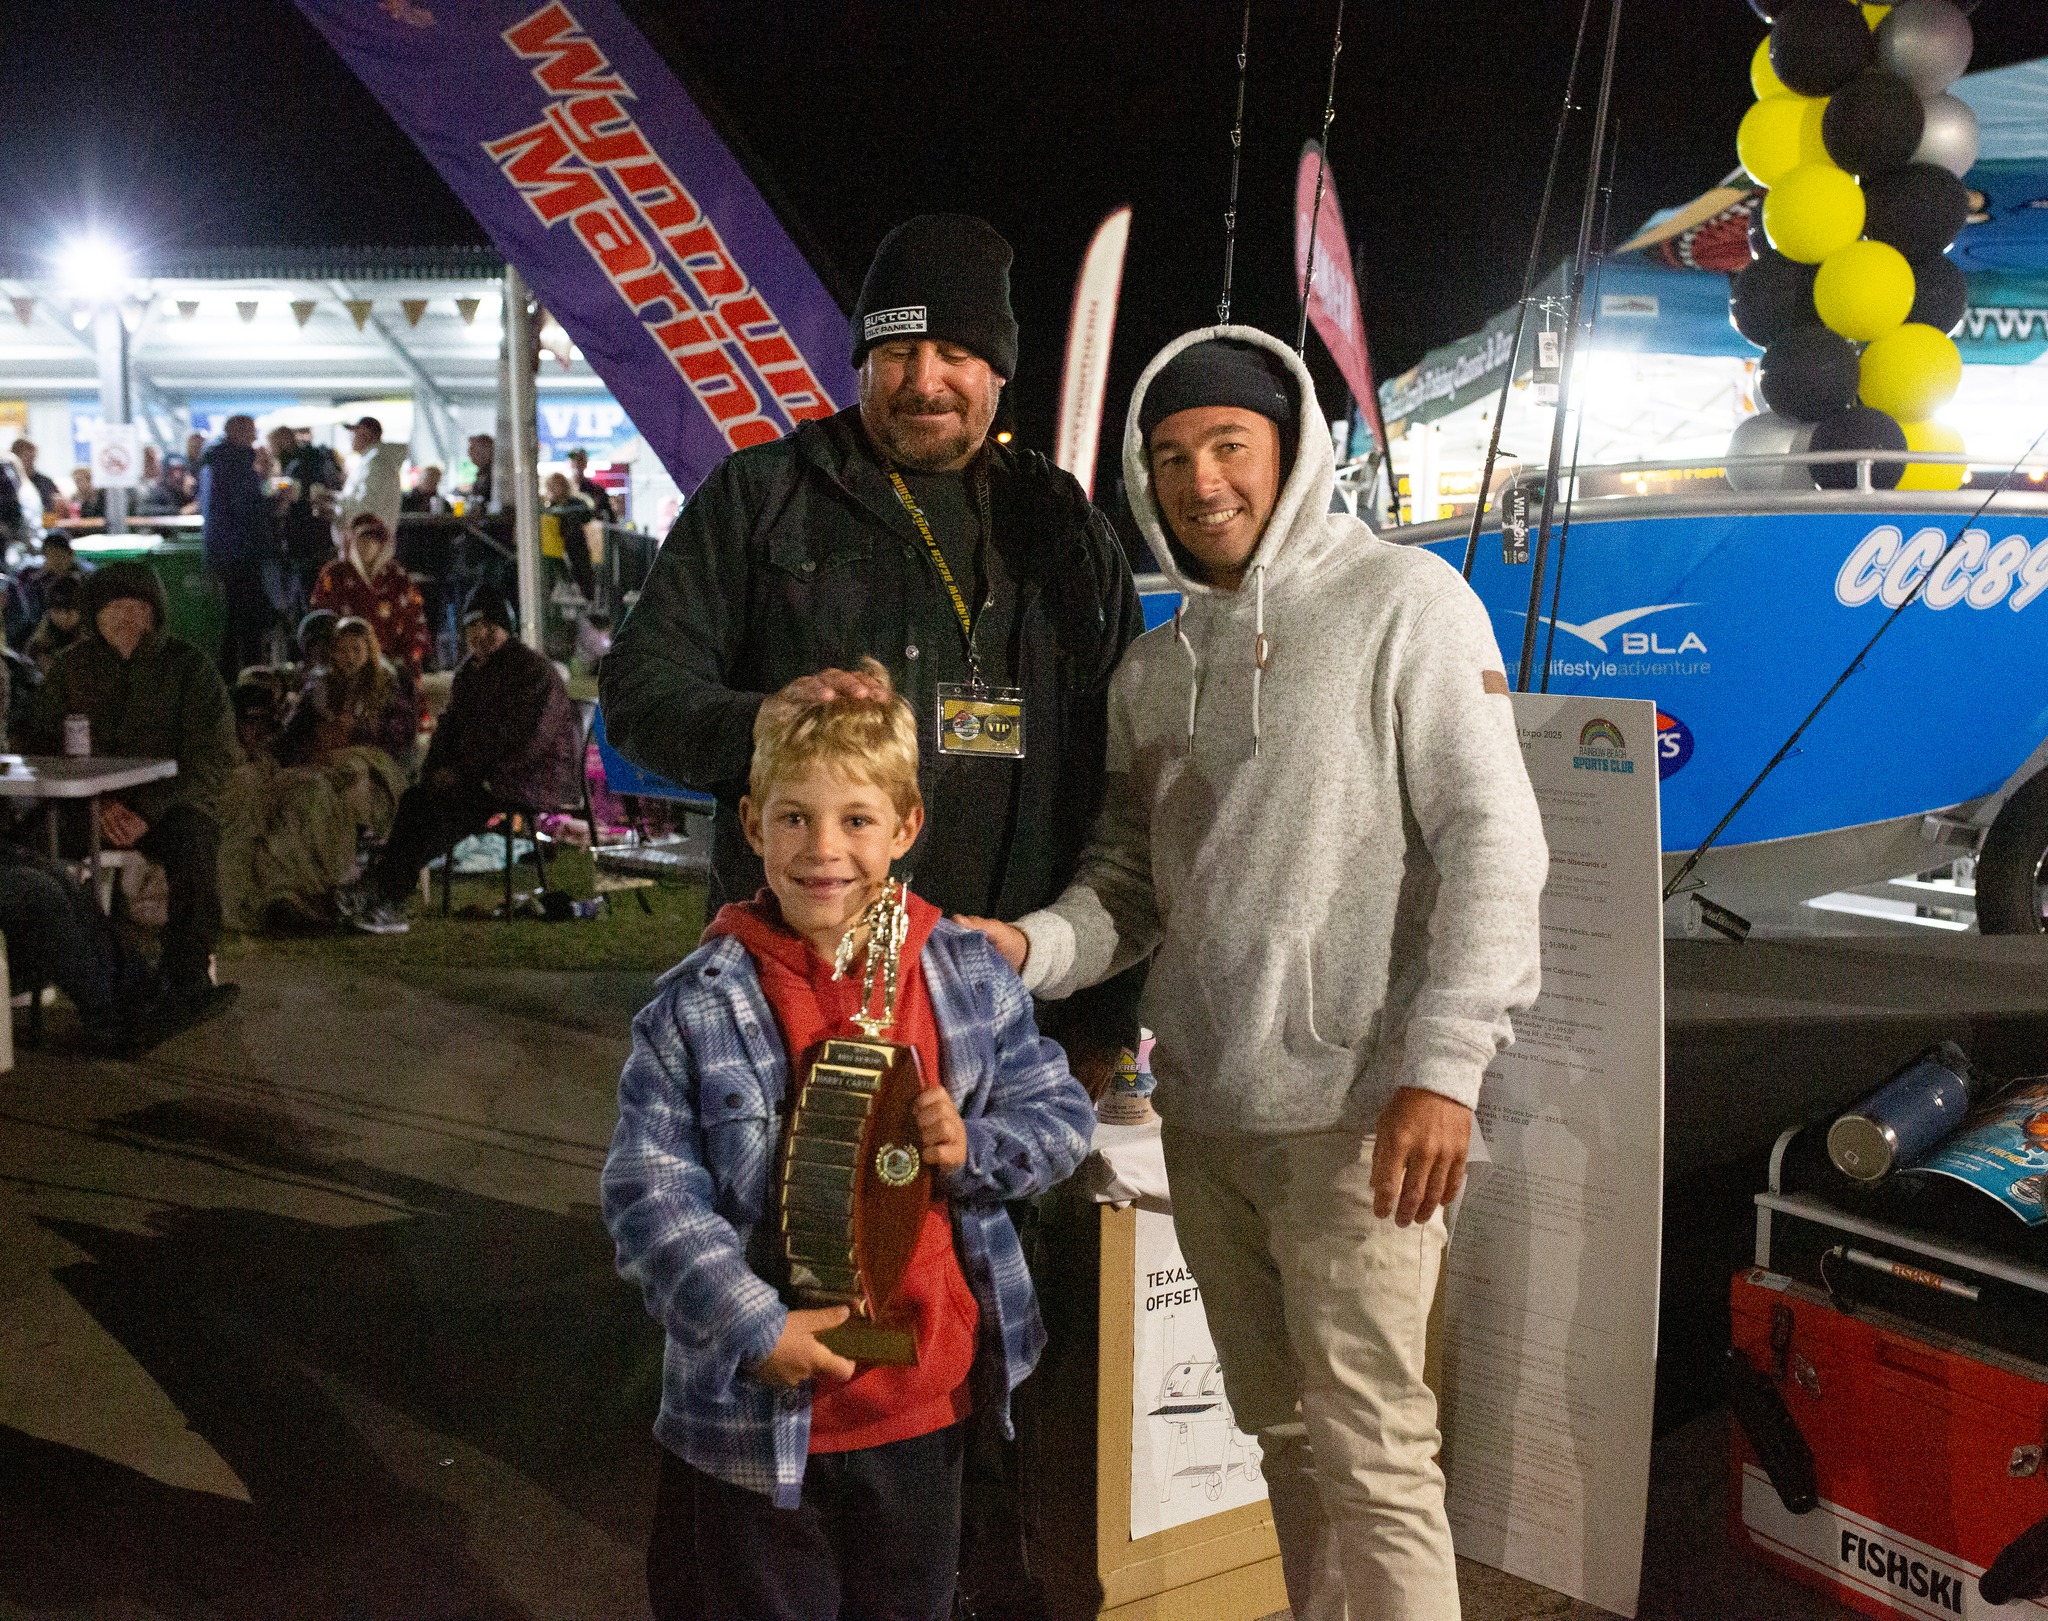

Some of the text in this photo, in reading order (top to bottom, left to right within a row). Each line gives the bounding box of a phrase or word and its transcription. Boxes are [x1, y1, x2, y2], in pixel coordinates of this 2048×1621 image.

[864, 310, 923, 328] BURTON
[888, 471, 918, 512] FISHING
[911, 511, 937, 548] FAMILY
[1513, 496, 1525, 547] WILSON
[930, 549, 955, 582] BEACH
[1622, 631, 1708, 655] BLA
[988, 722, 1010, 733] VIP
[1522, 729, 1542, 739] Expo
[1543, 730, 1563, 740] 2025
[1573, 756, 1634, 774] SPORTS CLUB
[1147, 1267, 1193, 1288] TEXAS
[1146, 1286, 1199, 1312] OFFSET
[1840, 1529, 1963, 1615] FISHSKI
